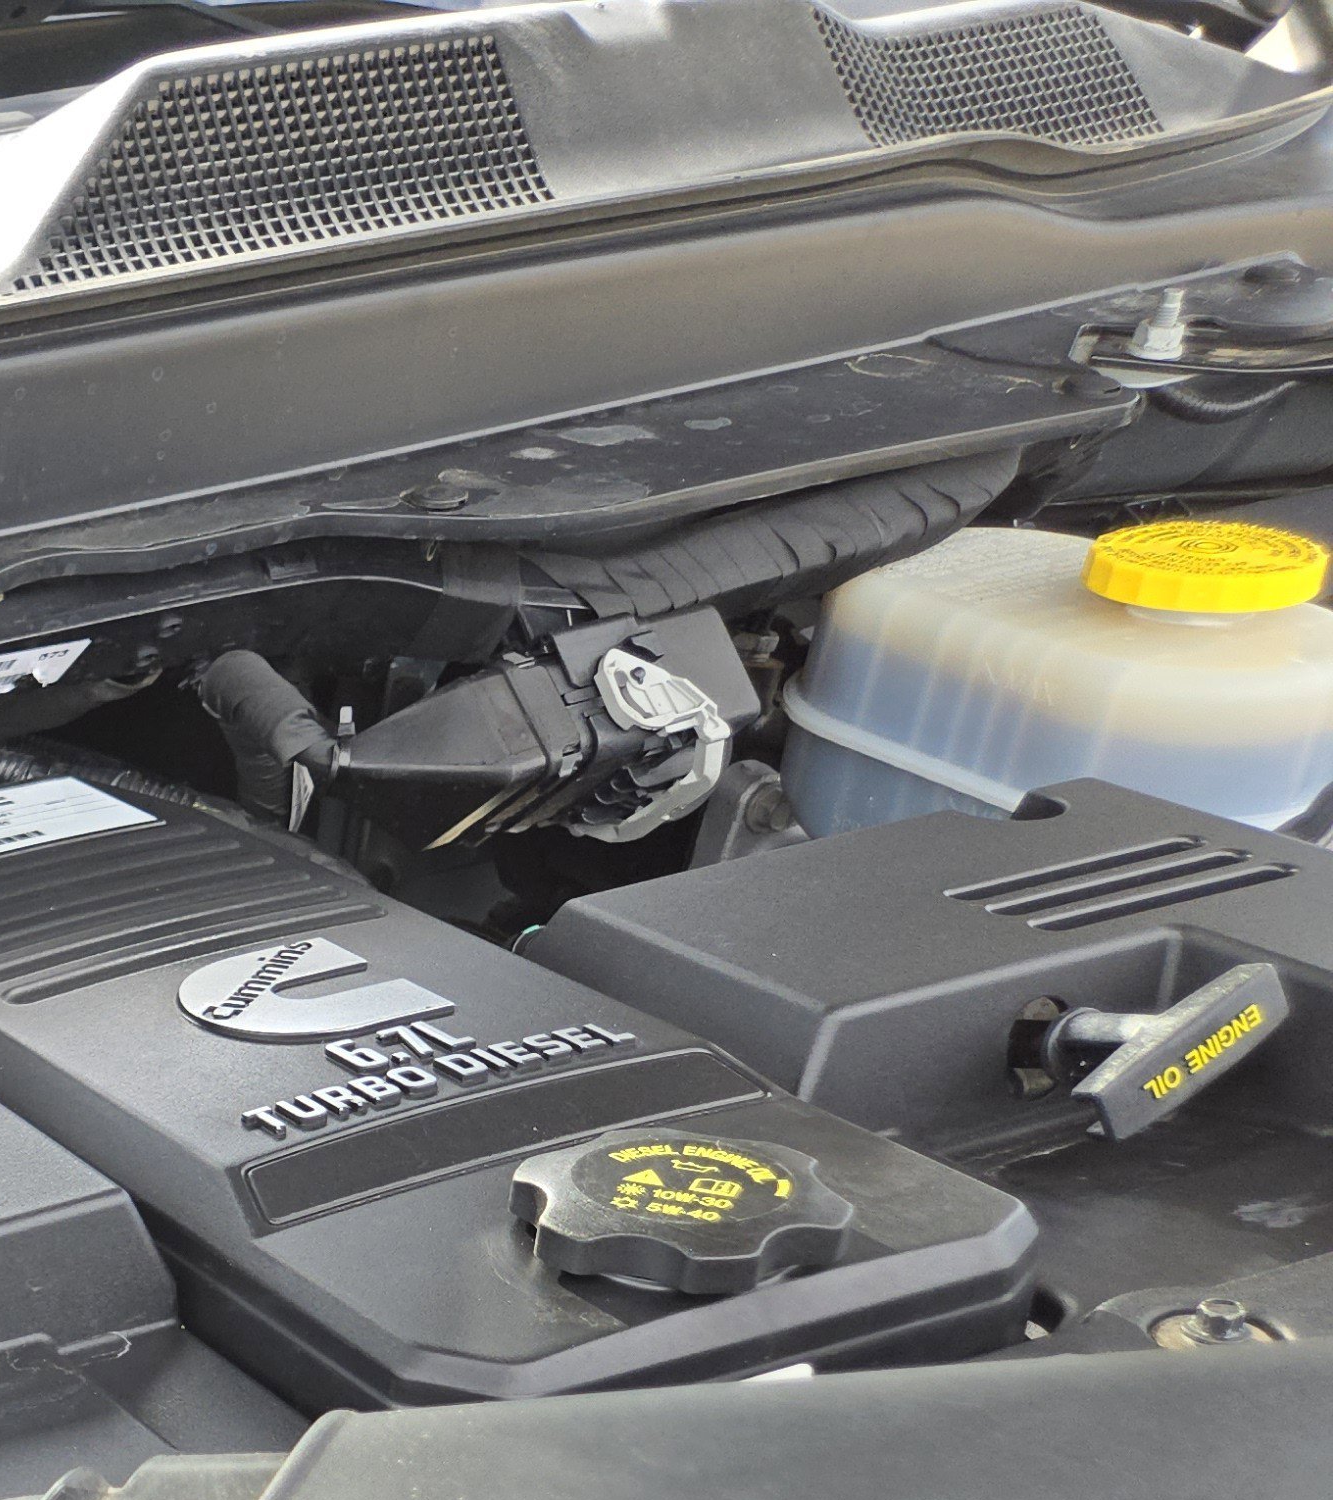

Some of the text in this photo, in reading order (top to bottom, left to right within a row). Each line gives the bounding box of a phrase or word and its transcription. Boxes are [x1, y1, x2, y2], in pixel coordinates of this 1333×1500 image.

[325, 1020, 476, 1075] 6.7L
[1143, 1003, 1262, 1099] ENGINE OIL
[241, 1023, 638, 1139] TURBO DIESEL
[608, 1144, 679, 1163] DIESEL
[682, 1145, 759, 1170] ENGINE
[645, 1202, 722, 1223] 5W-40
[653, 1188, 735, 1210] 10W-30
